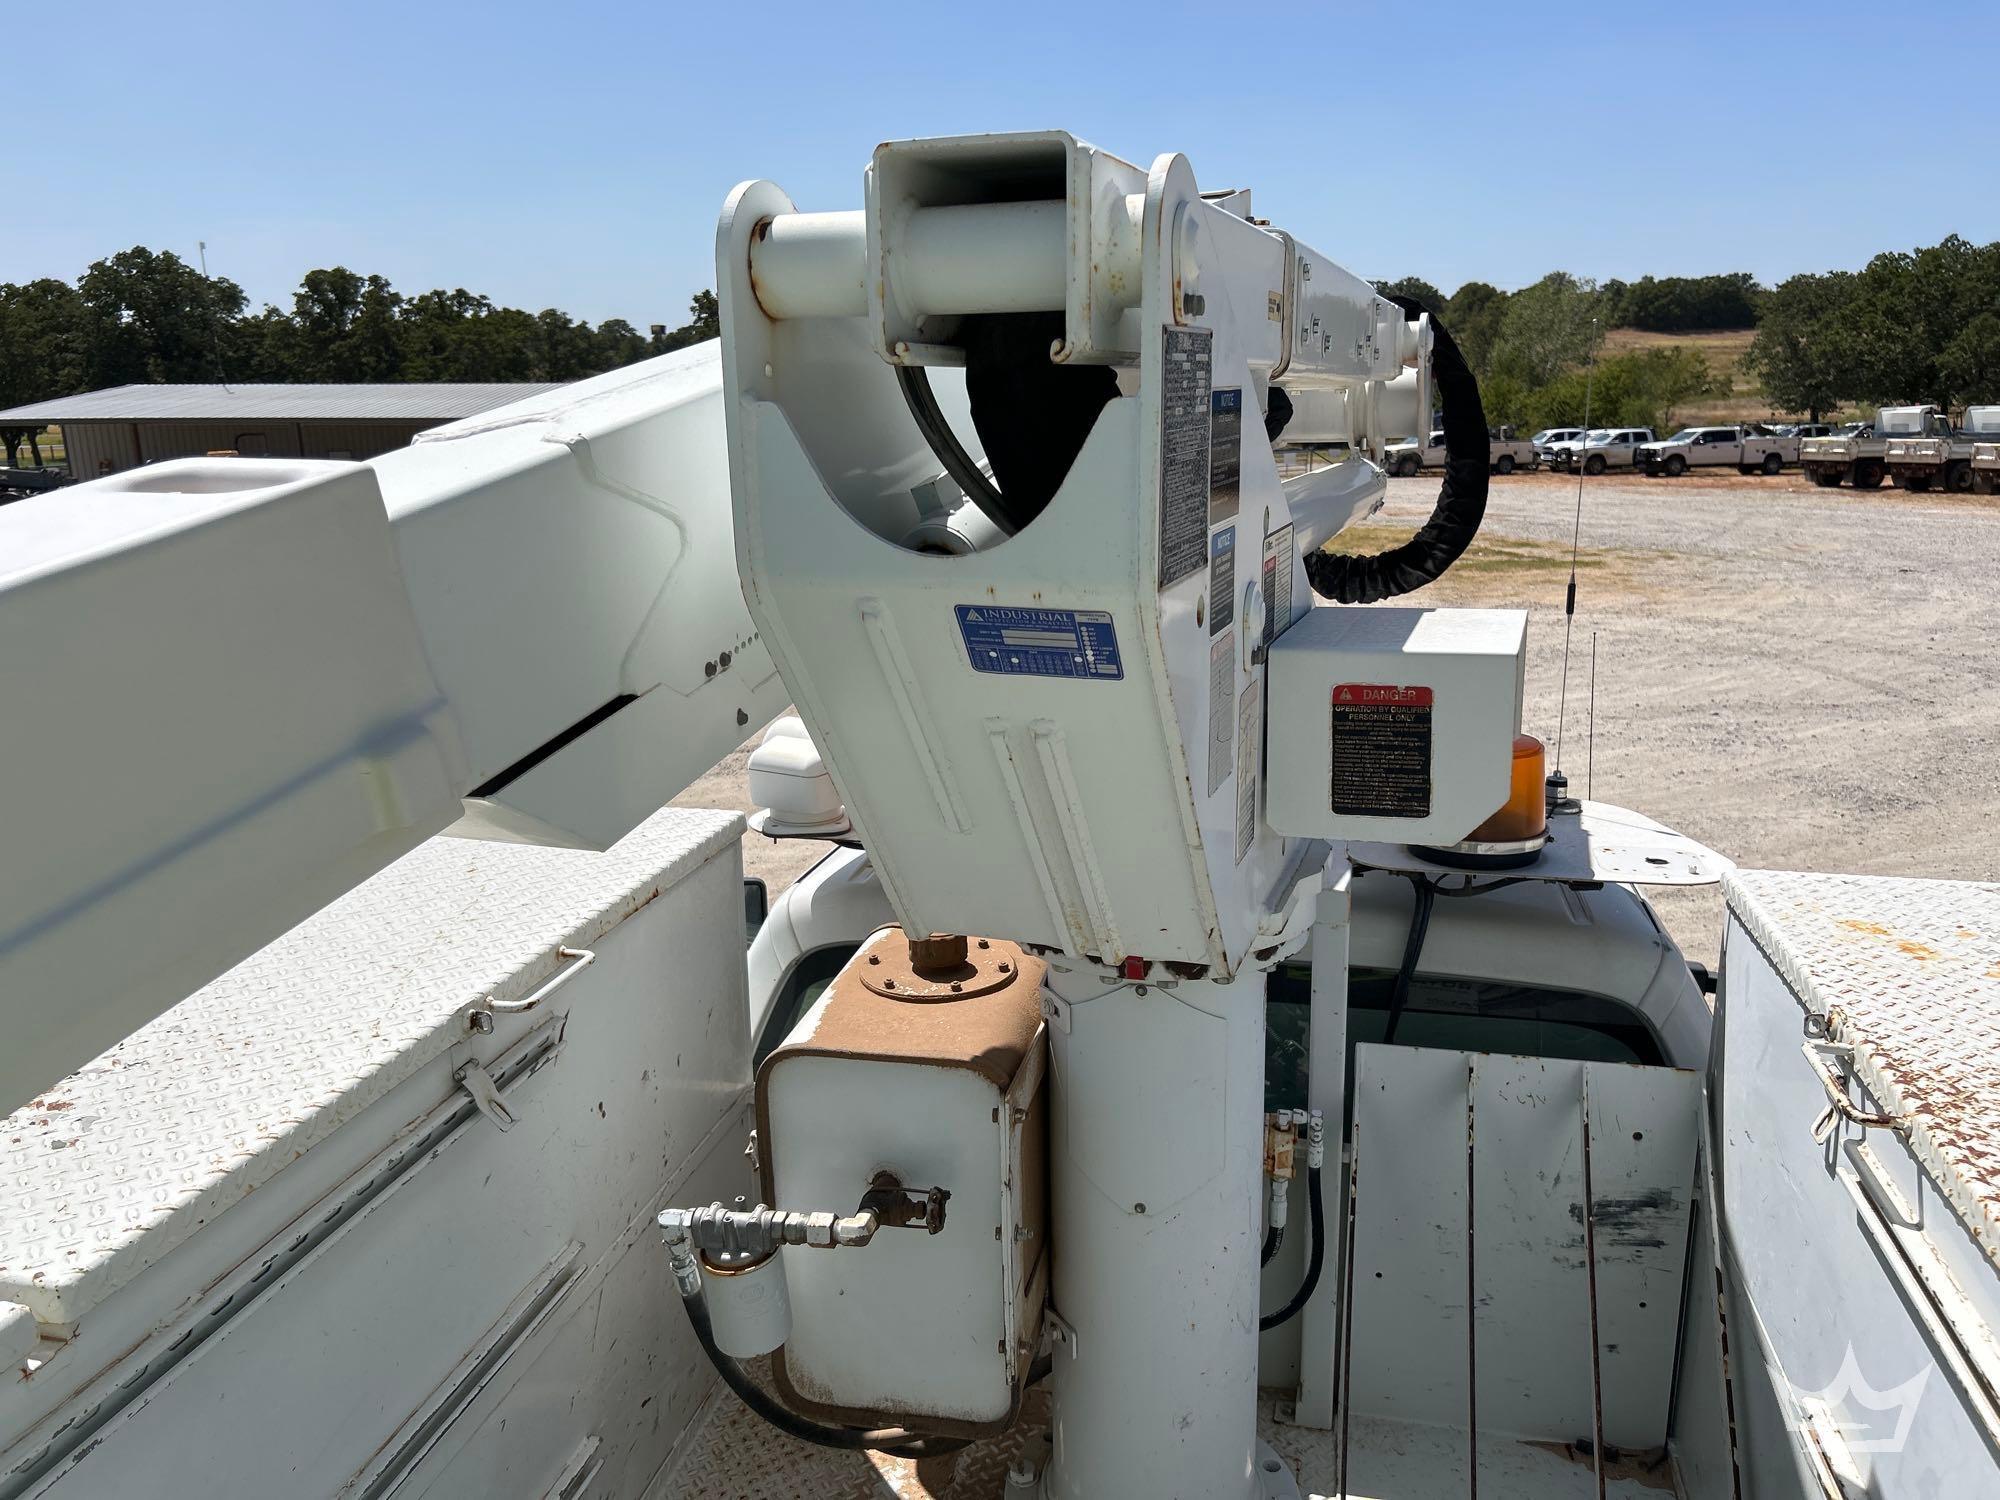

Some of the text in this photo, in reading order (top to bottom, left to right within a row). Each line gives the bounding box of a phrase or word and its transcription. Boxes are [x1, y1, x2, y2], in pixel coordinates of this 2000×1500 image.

[983, 609, 1069, 622] INDUSTRIAL
[1363, 689, 1416, 701] DANGER
[1335, 705, 1377, 713] OPERATION
[1349, 713, 1415, 722] PERSONNEL ONLY
